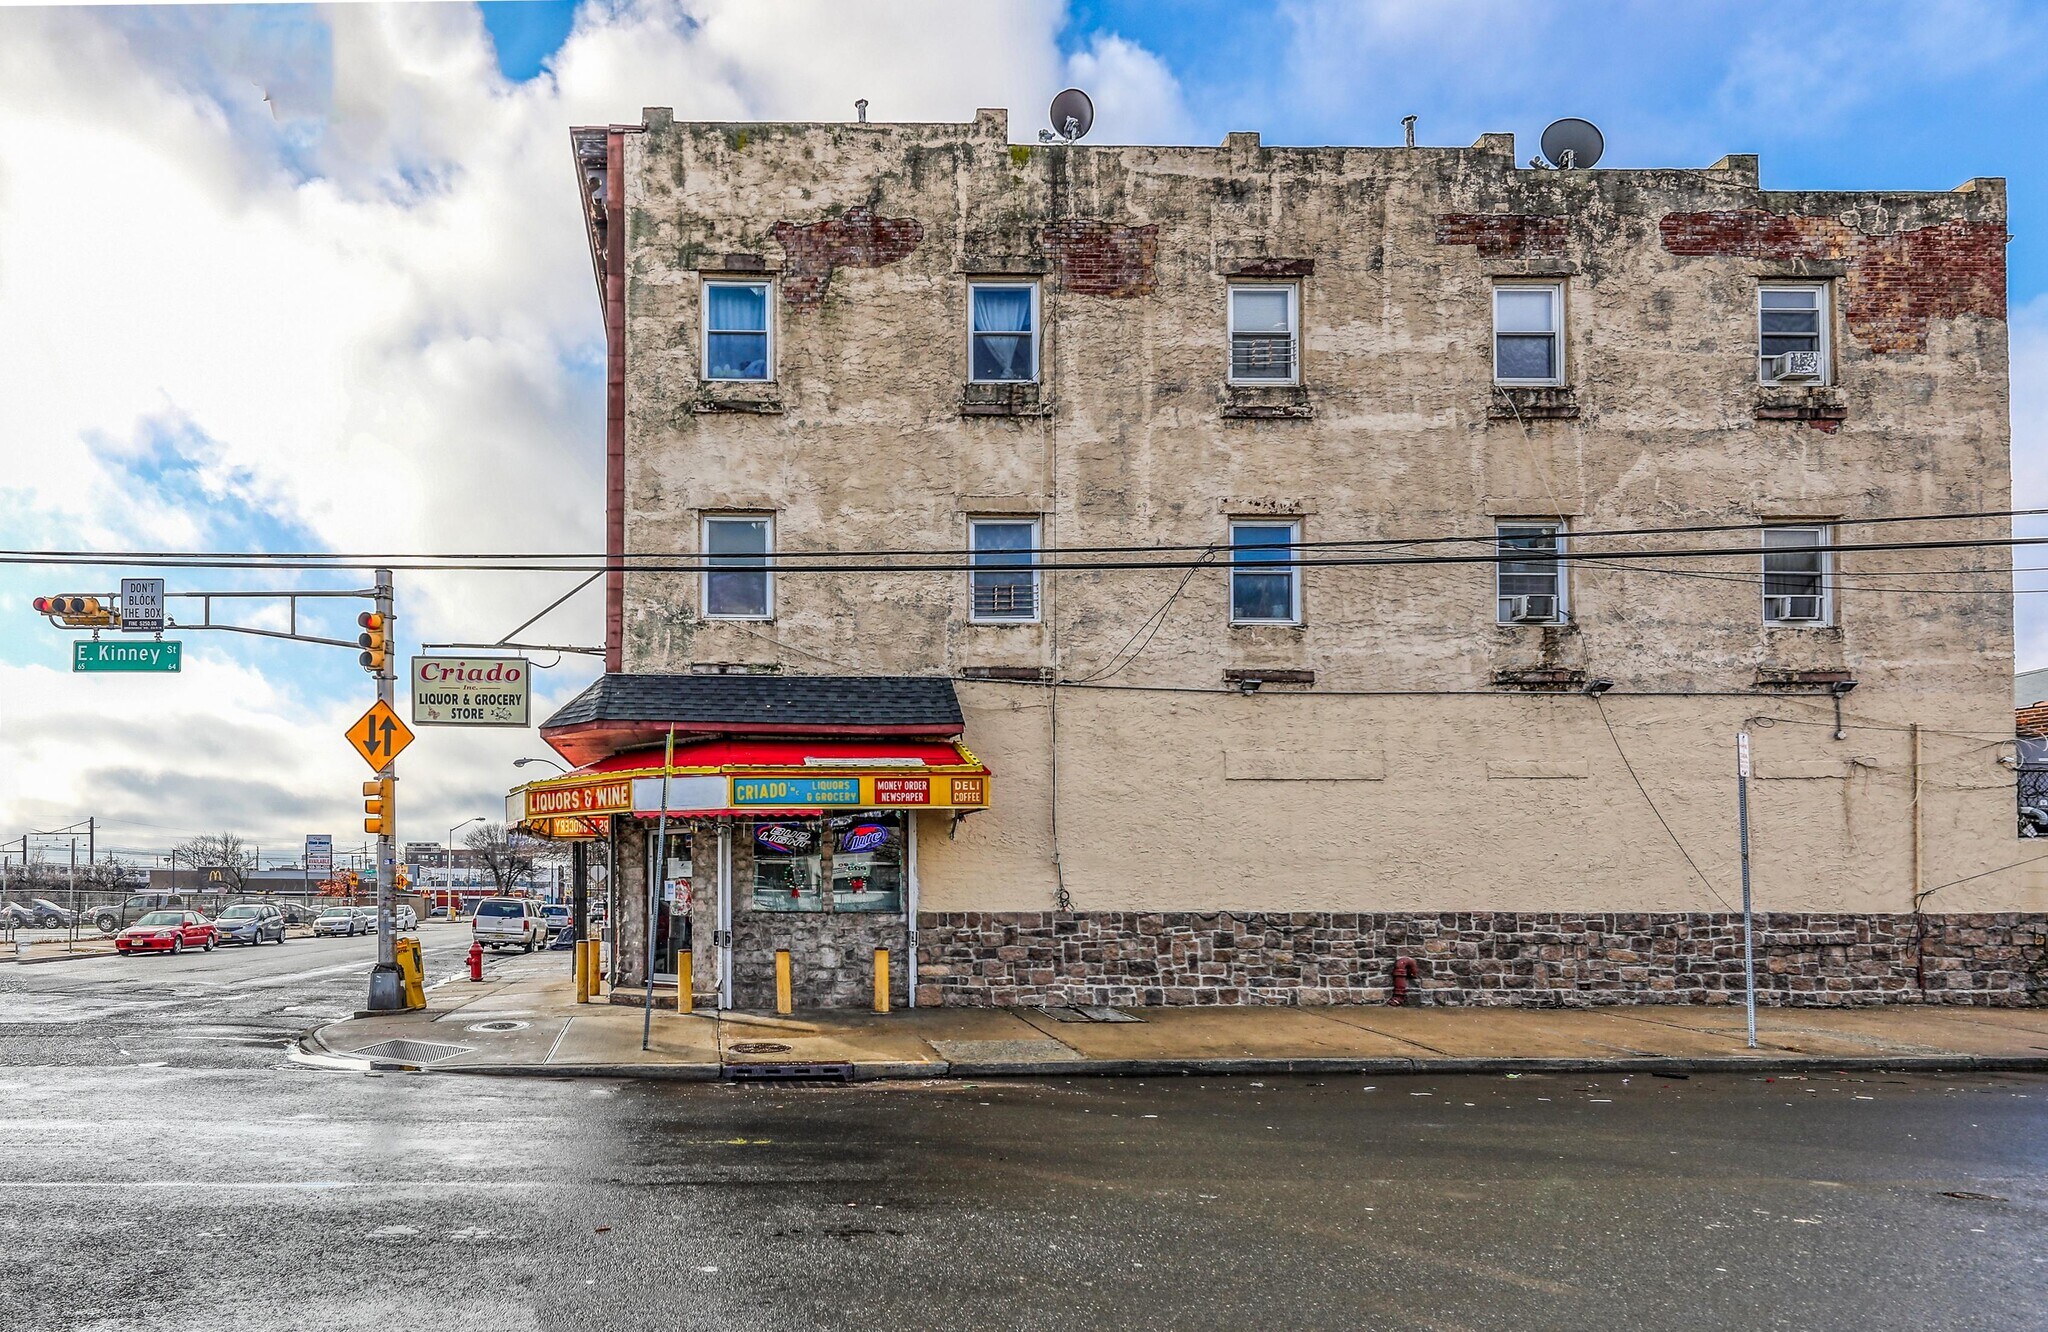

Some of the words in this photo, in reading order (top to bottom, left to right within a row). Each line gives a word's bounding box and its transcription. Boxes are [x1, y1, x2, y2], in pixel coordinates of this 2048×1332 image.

[131, 583, 155, 592] DON'T
[129, 595, 156, 605] BLOCK
[124, 608, 140, 618] THE
[145, 608, 161, 618] BOX
[78, 645, 94, 661] E.
[98, 645, 160, 665] Kinney
[166, 645, 177, 654] St
[419, 661, 521, 683] Criado
[419, 693, 459, 705] LIQUOR
[463, 694, 470, 705] &
[475, 694, 522, 706] GROCERY
[451, 708, 484, 719] STORE
[812, 781, 851, 790] LIQUORS
[877, 781, 902, 790] MONEY
[904, 780, 927, 790] ORDER
[954, 781, 980, 790] DELI
[736, 782, 787, 801] CRIADO
[806, 792, 813, 801] &
[815, 792, 857, 801] GROCERY
[529, 790, 580, 812] LIQUORS
[584, 789, 592, 808] &
[596, 785, 628, 806] WINE
[881, 792, 924, 802] NEWSPAPER
[954, 792, 980, 802] COFFEE
[770, 826, 811, 841] BUD
[759, 831, 812, 848] LIGHT
